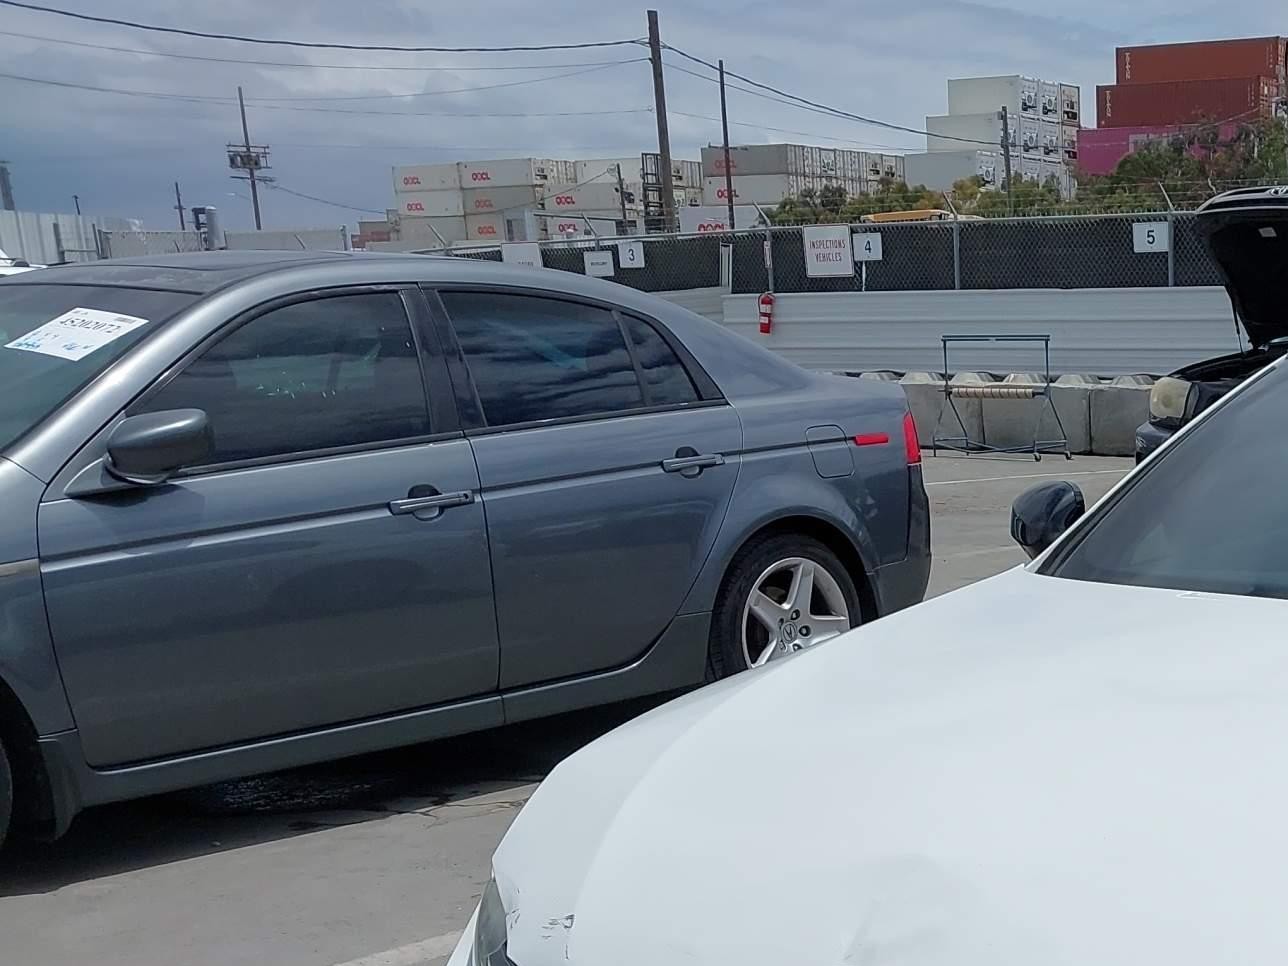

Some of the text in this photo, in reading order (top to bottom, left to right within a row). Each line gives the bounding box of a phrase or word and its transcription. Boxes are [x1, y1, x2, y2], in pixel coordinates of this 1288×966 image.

[472, 172, 491, 182] OOCL
[1146, 229, 1156, 245] 5
[809, 239, 846, 250] INSPECTIONS
[864, 240, 872, 253] 4
[628, 248, 635, 261] 3
[815, 252, 842, 263] VEHICLES
